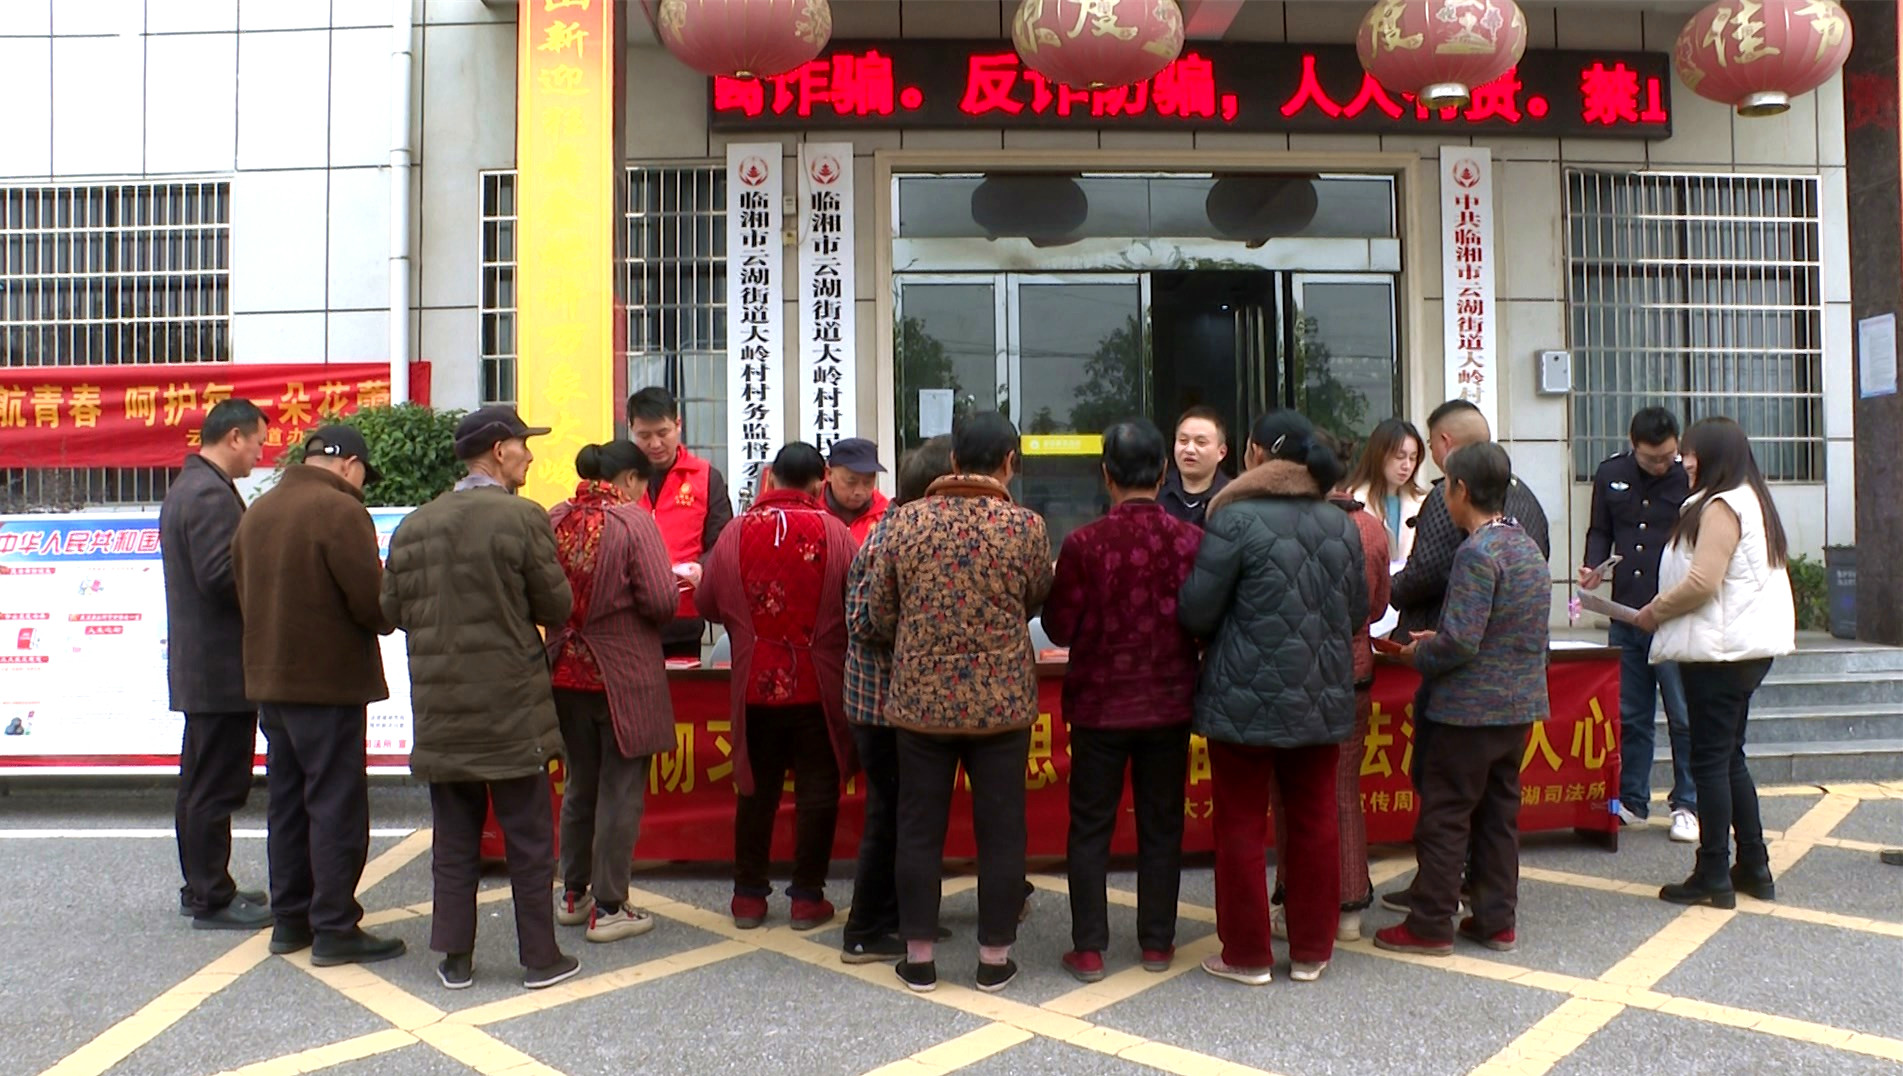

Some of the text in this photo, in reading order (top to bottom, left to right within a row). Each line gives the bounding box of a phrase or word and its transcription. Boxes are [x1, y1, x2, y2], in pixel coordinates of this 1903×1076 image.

[1703, 0, 1845, 67] 佳节
[0, 383, 102, 429] 航青春
[0, 529, 160, 554] 中华人民共和国
